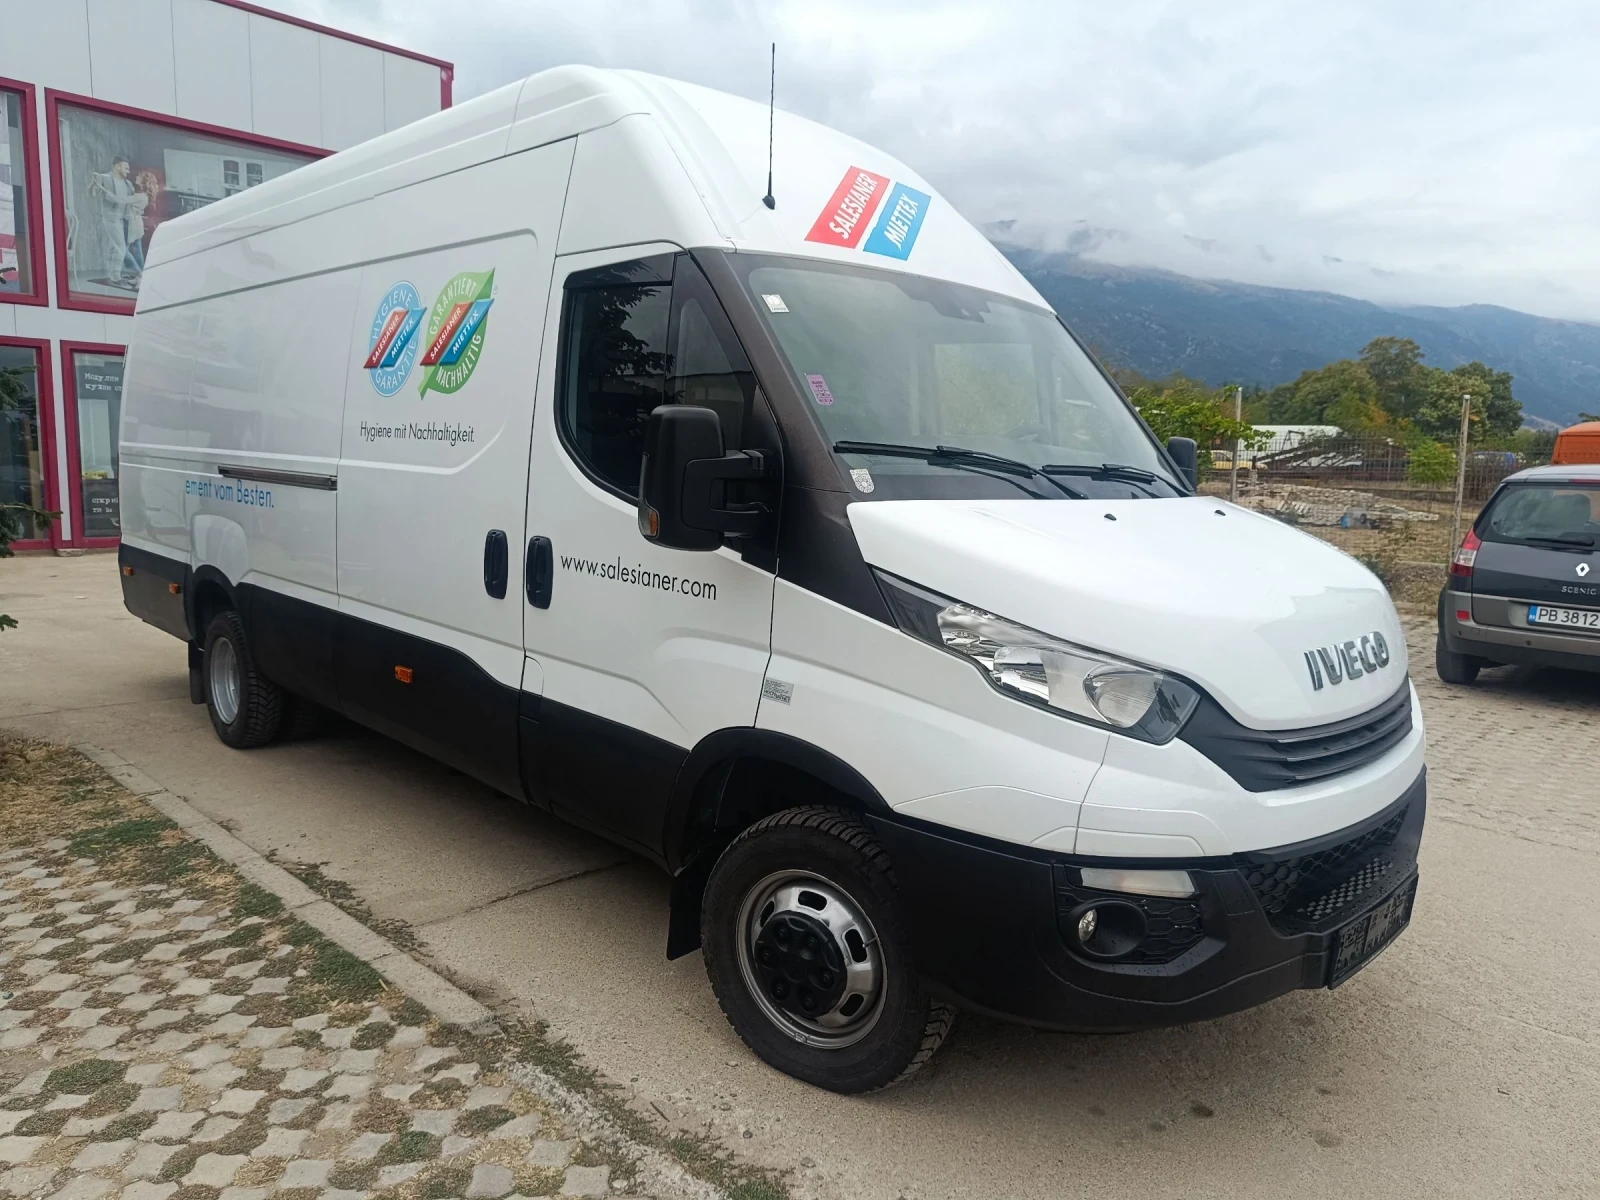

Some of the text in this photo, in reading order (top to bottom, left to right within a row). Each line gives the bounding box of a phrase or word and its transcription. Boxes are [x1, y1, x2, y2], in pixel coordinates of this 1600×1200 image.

[828, 172, 878, 240] SALESIANER
[883, 193, 919, 251] MIETTEX
[372, 288, 413, 339] HYGIENE
[429, 277, 477, 335] GARANTIERT
[372, 313, 400, 363] SALESIANER
[391, 317, 415, 359] MIETTEX
[429, 306, 462, 360] SALESIANER
[452, 309, 479, 355] MIETTEX
[375, 340, 417, 390] GARANTIE
[435, 333, 482, 389] NACHHALTIG
[360, 420, 475, 447] Hygiene mit Nachhaltigkeit.
[185, 479, 275, 509] ement vom Besten.
[560, 555, 717, 601] www.salesianer.com
[1561, 585, 1597, 595] SCENIC
[1538, 608, 1599, 627] PB 3812
[1304, 630, 1390, 692] IVECO
